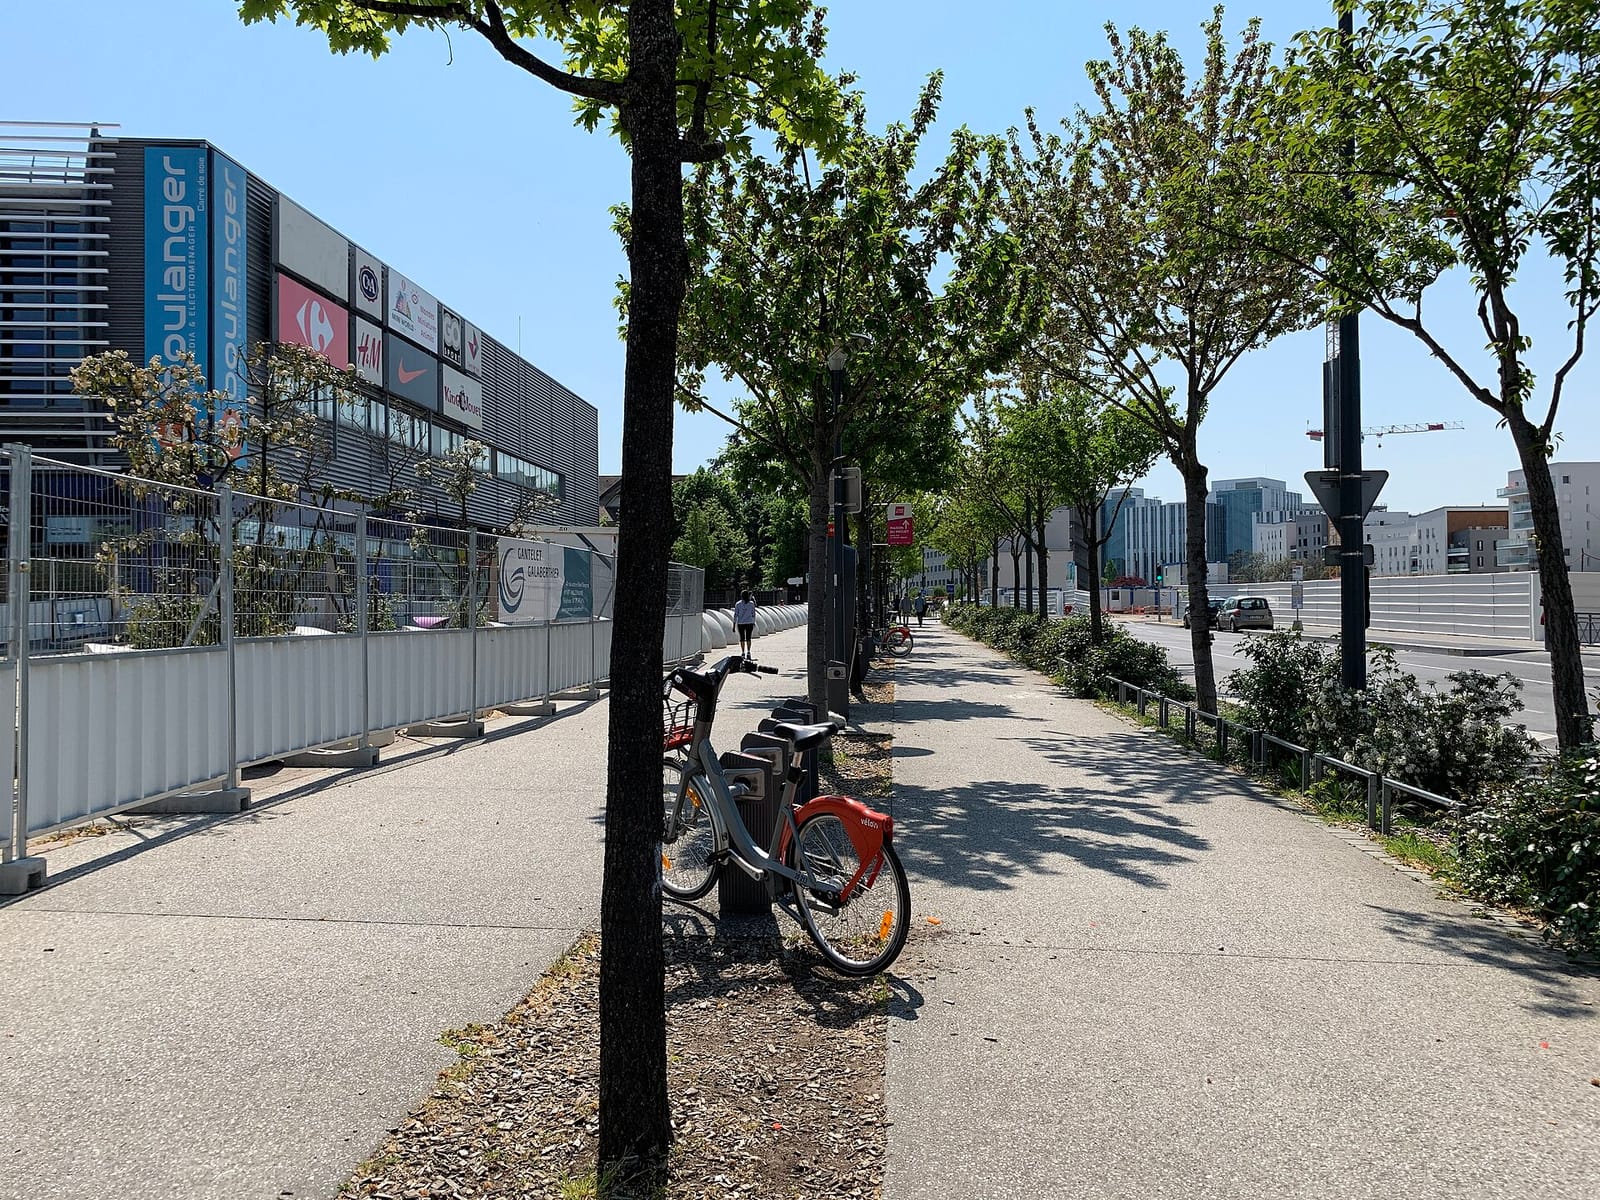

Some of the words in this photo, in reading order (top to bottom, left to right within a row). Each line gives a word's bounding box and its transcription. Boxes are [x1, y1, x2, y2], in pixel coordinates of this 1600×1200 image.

[188, 225, 196, 317] ELECTROMENAGER
[221, 167, 241, 399] boulanger
[443, 313, 461, 351] GO
[357, 331, 381, 374] H&M
[444, 346, 461, 363] SPORT
[517, 547, 542, 561] GANTELET
[527, 565, 560, 578] GALABERTHIER
